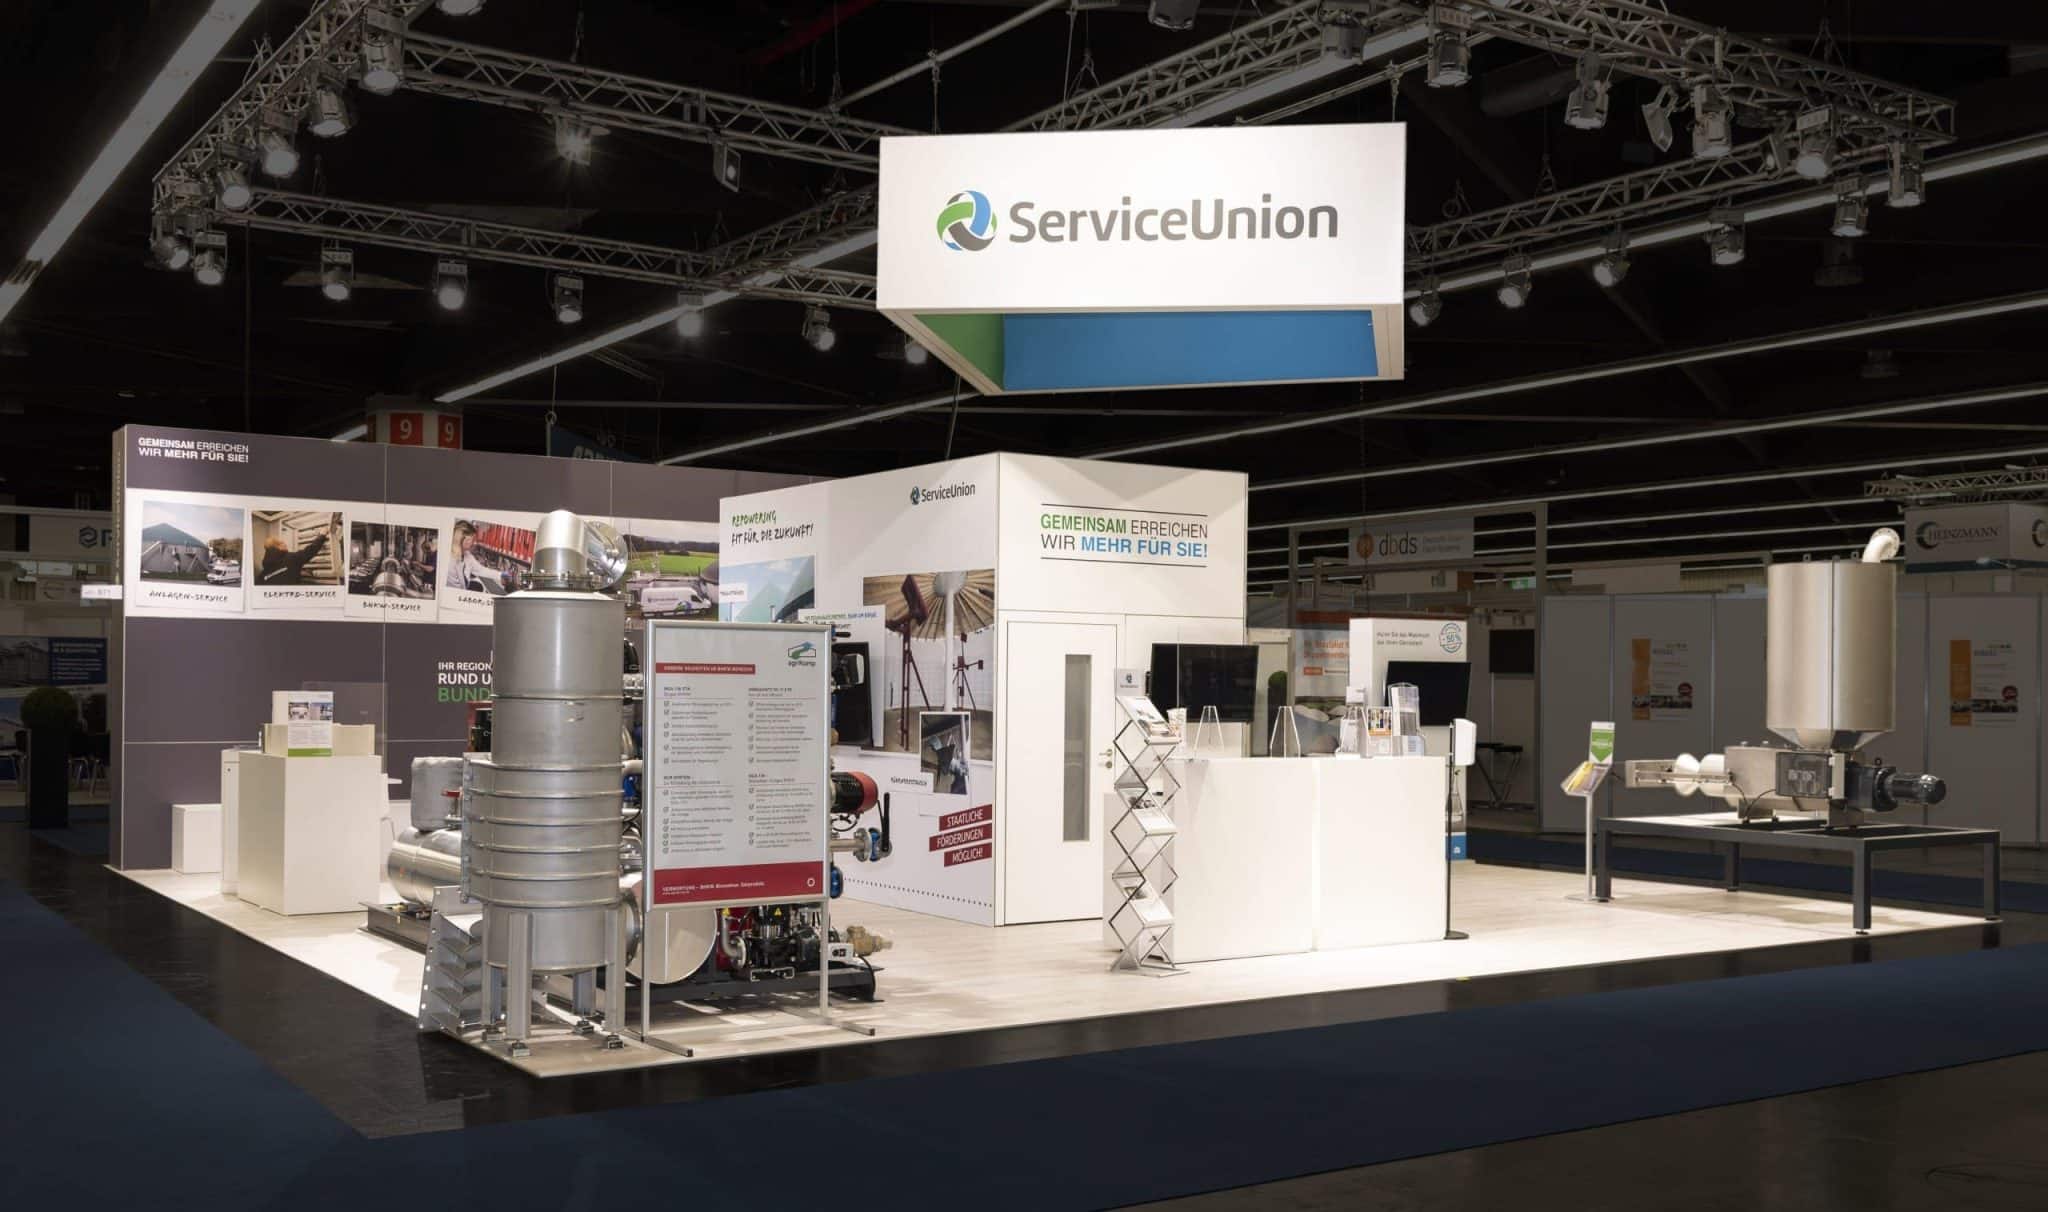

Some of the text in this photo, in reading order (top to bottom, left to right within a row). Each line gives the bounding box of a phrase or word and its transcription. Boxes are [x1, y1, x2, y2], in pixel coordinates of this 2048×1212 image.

[1009, 193, 1338, 243] ServiceUnion
[400, 419, 412, 440] 9
[445, 422, 455, 442] 9
[138, 437, 249, 453] GEMEINSAM ERREICHEN
[138, 447, 249, 463] WIR MEHR FÜR SIE!
[921, 481, 976, 502] ServiceUnion
[732, 510, 777, 527] REPOWERING
[1040, 513, 1208, 538] GEMEINSAM ERREICHEN
[731, 523, 814, 546] FIT FÜR DIE ZUKUNFT!
[1040, 534, 1208, 558] WIR MEHR FÜR SIE!
[438, 662, 454, 671] IHR
[438, 673, 478, 685] RUND
[947, 809, 983, 827] STAATLICHE
[936, 828, 983, 848] FÖRDERUNGEN
[952, 848, 983, 863] MÖGLICH!
